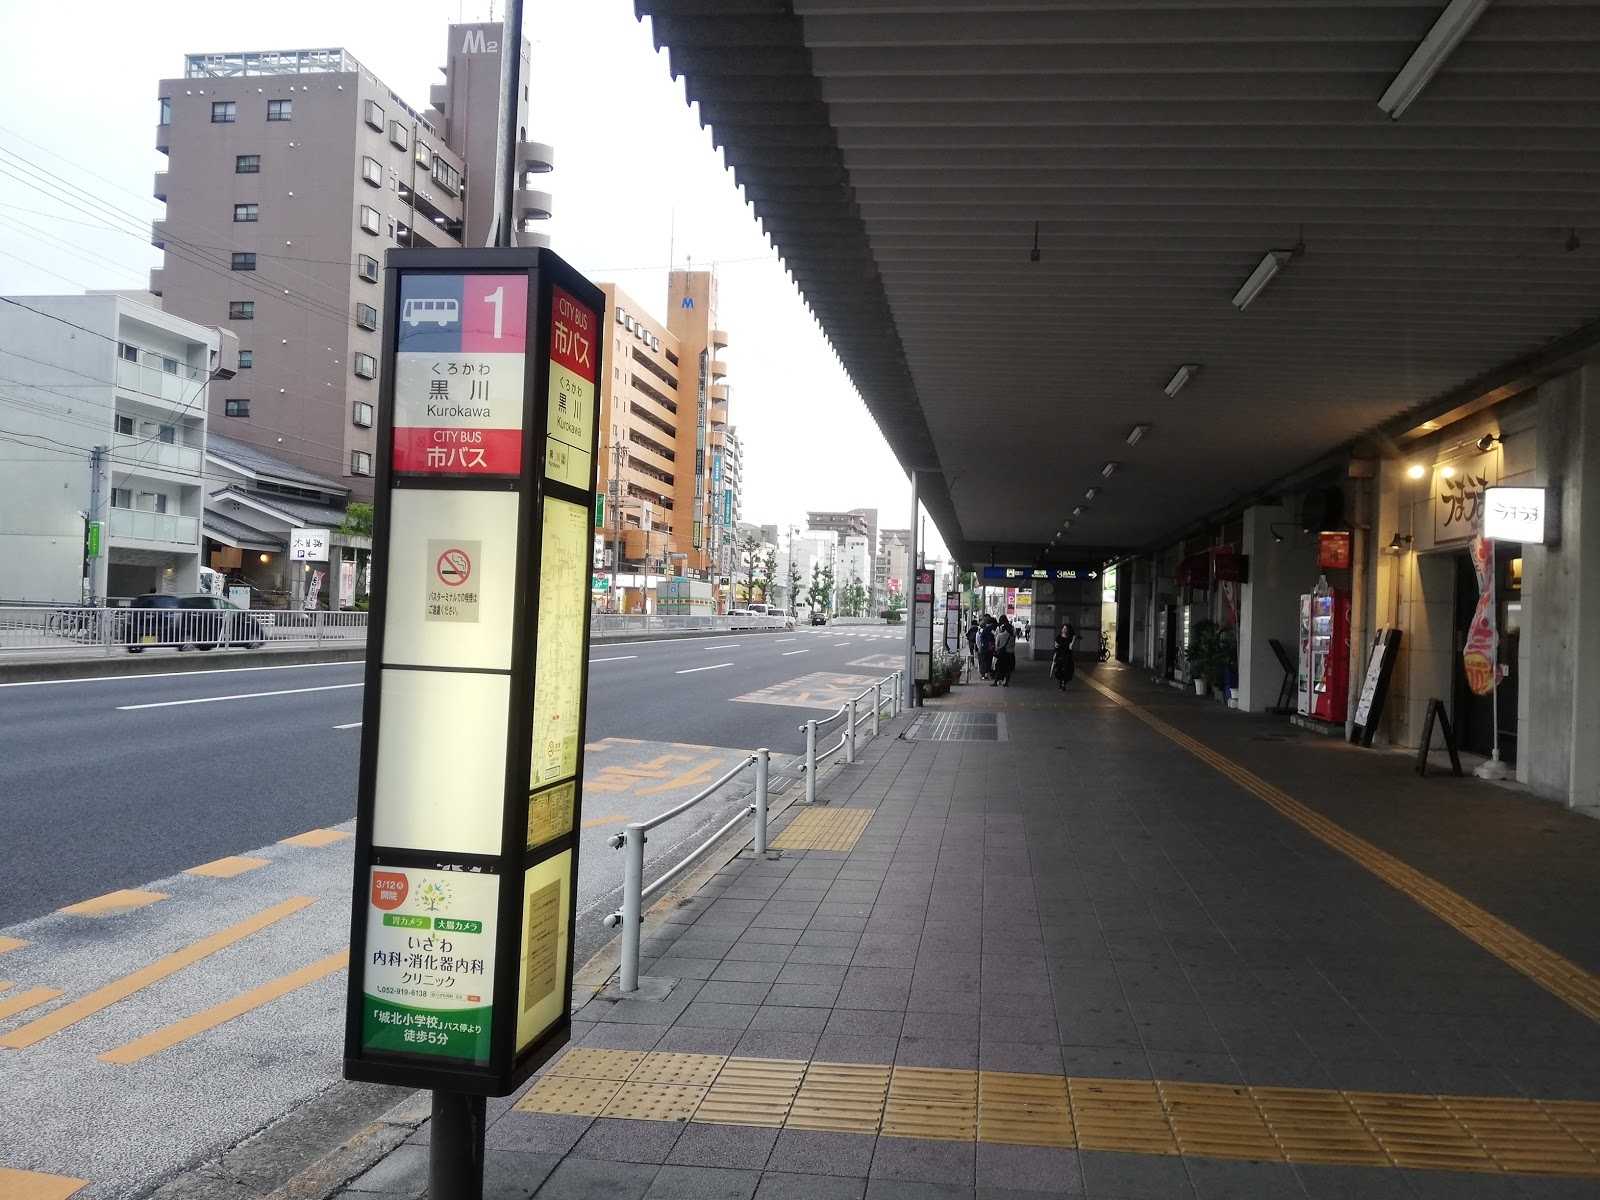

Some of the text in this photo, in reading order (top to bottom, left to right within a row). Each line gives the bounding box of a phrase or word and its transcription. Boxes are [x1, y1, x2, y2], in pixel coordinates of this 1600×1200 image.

[484, 286, 503, 338] 1
[560, 298, 588, 330] CITY BUS
[553, 320, 590, 368] 市バス
[431, 362, 490, 375] くろかわ
[429, 380, 489, 400] 黒川
[559, 377, 583, 397] くろかわ
[427, 404, 490, 417] Kurokawa
[558, 392, 582, 422] 黒川
[557, 416, 582, 437] Kurokawa
[433, 431, 482, 443] CITY BUS
[427, 446, 487, 468] 市バス
[392, 915, 424, 927] 胃カメラ
[438, 919, 479, 931] 大腸カメラ
[373, 951, 484, 975] 内科・消化器内科
[400, 972, 456, 988] クリニック
[404, 1028, 449, 1045] 徒歩5分
